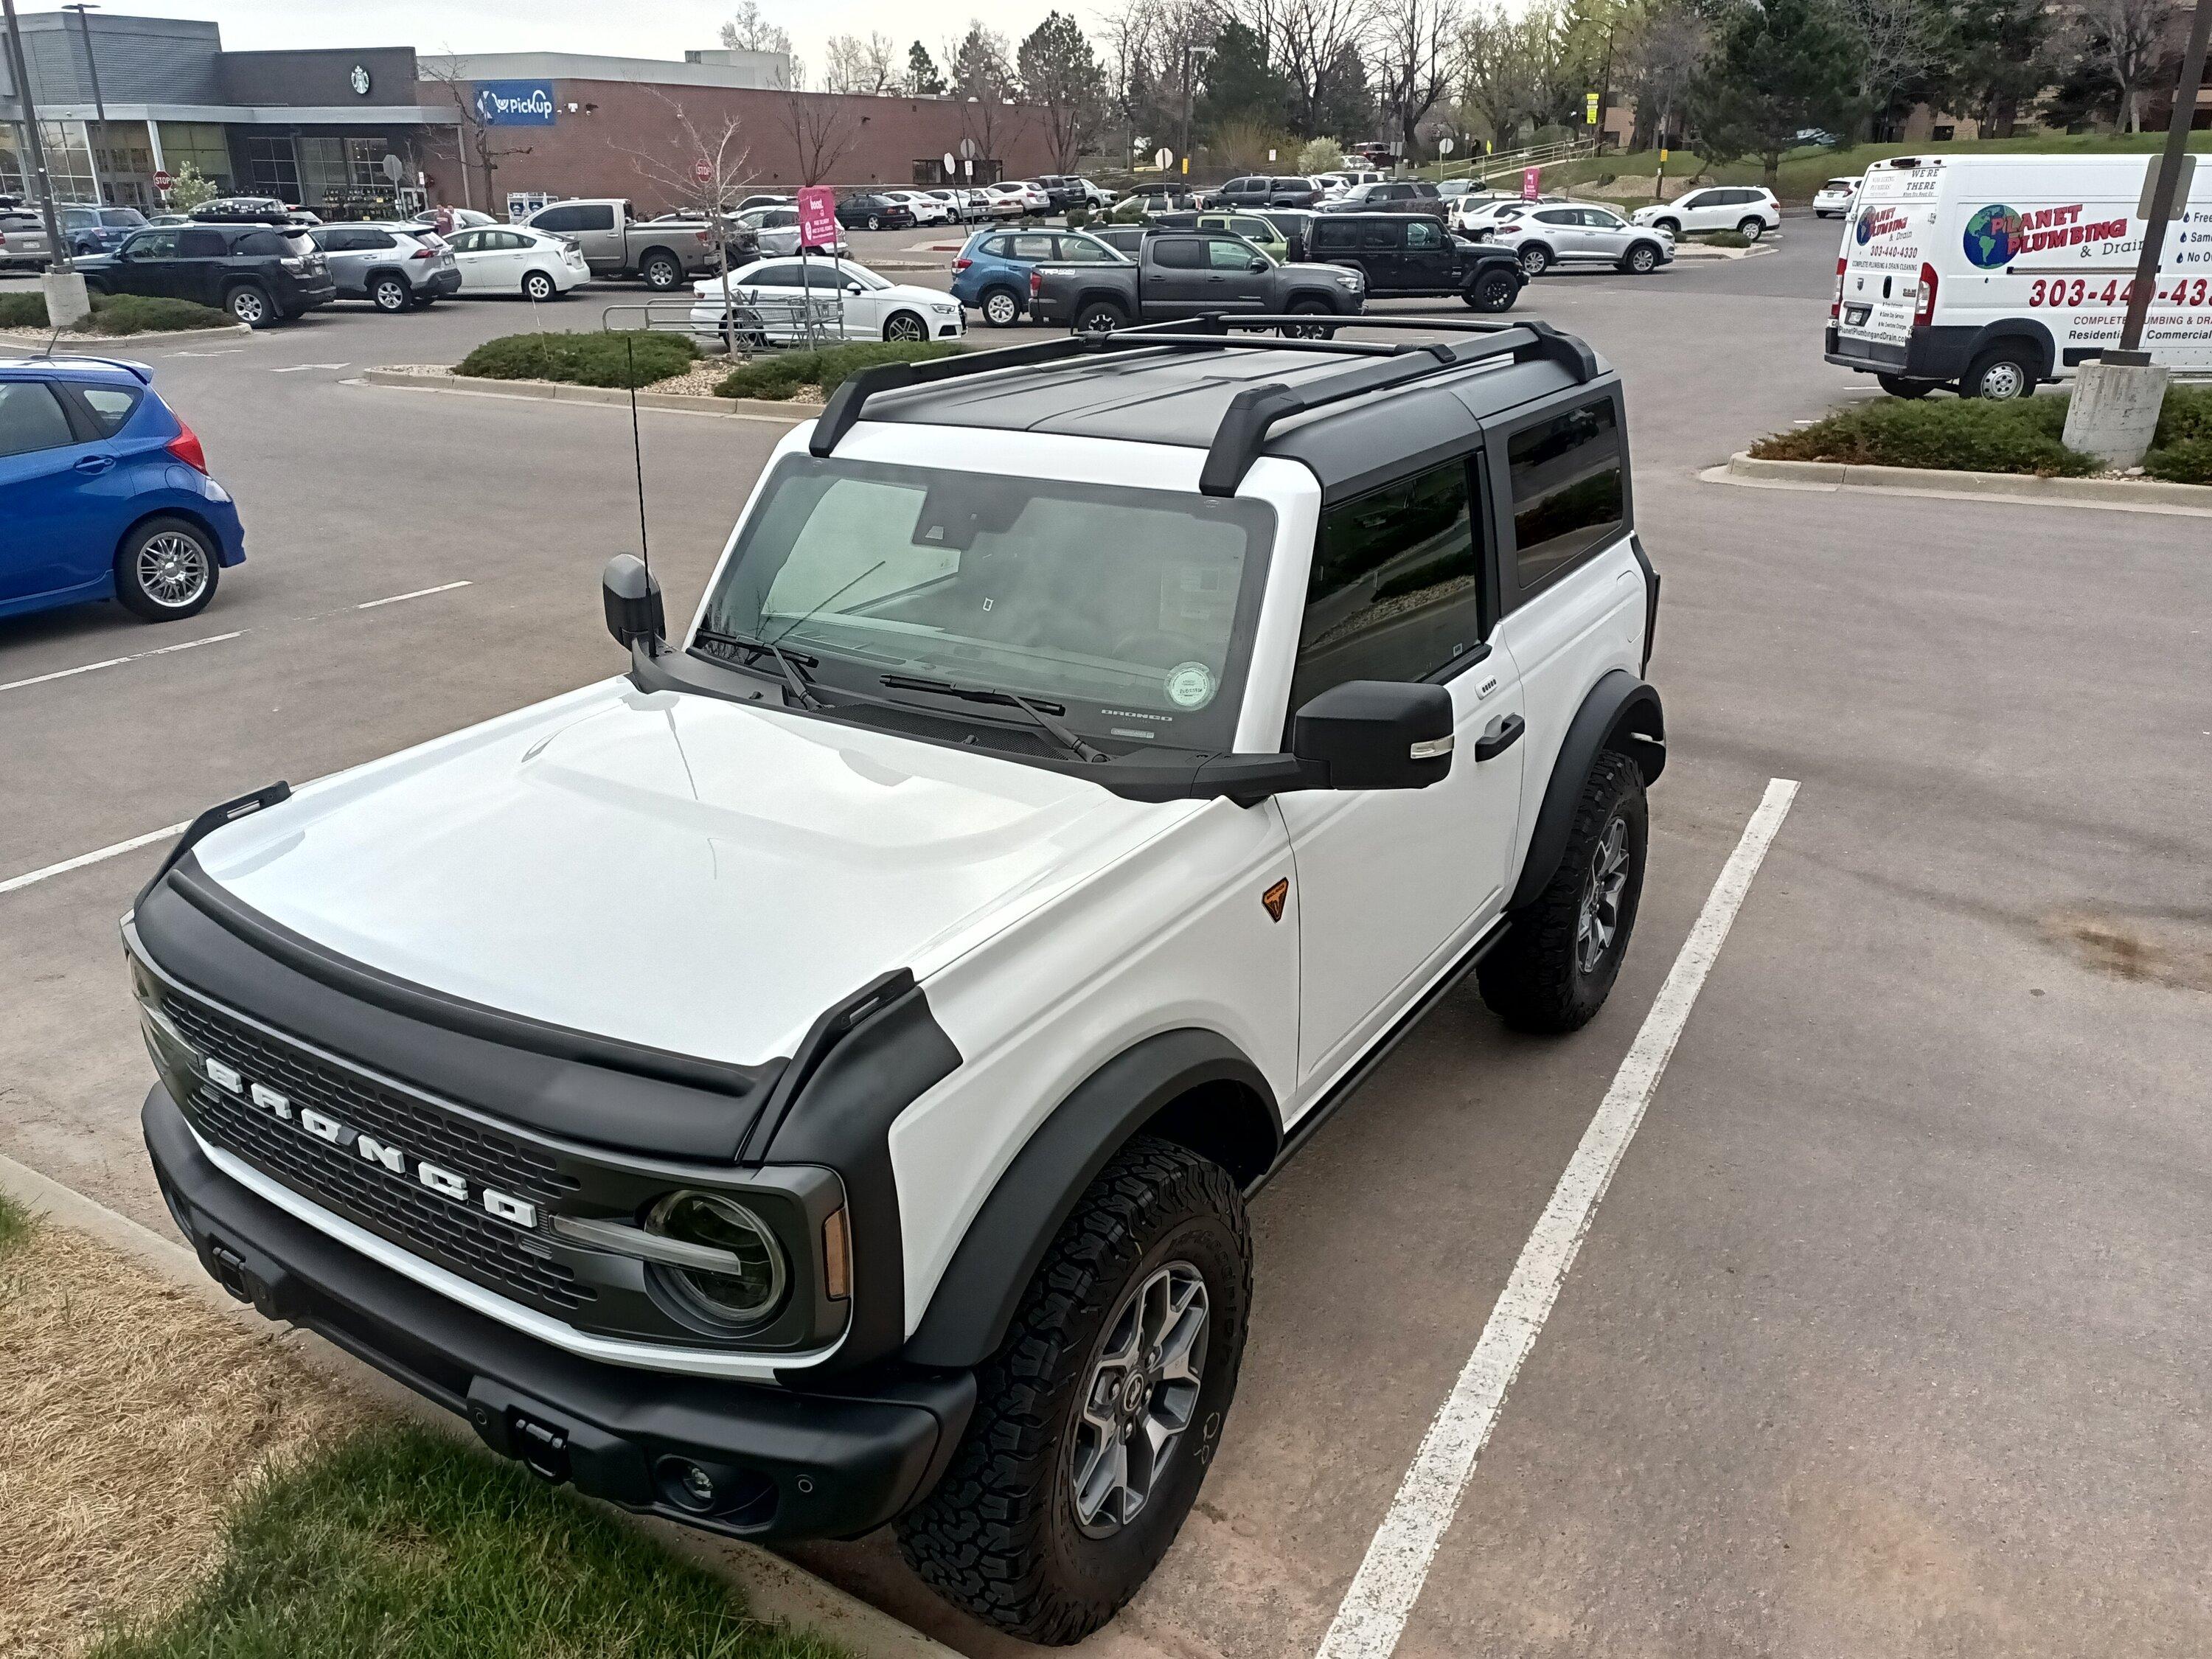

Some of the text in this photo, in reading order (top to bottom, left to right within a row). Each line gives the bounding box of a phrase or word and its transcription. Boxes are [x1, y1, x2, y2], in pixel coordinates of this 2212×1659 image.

[1912, 169, 1940, 177] WE'RE
[155, 176, 170, 184] STOP
[1906, 181, 1936, 190] THERE
[1992, 204, 2083, 236] PLANET
[2194, 212, 2212, 223] Free
[1870, 216, 1909, 237] PLUMBING
[1896, 231, 1913, 241] Drain
[2008, 218, 2128, 254] PLUMBING
[2191, 232, 2212, 243] Sam
[1870, 246, 1918, 258] 303-440-4330
[2080, 246, 2092, 258] &
[2187, 251, 2212, 262] No O
[2029, 279, 2212, 307] 303-44-43
[2187, 316, 2193, 324] &
[2197, 316, 2212, 324] DR
[2069, 330, 2212, 339] Residenti Commercial
[1102, 709, 1172, 721] BRONCO
[205, 1057, 538, 1228] BRONCO
